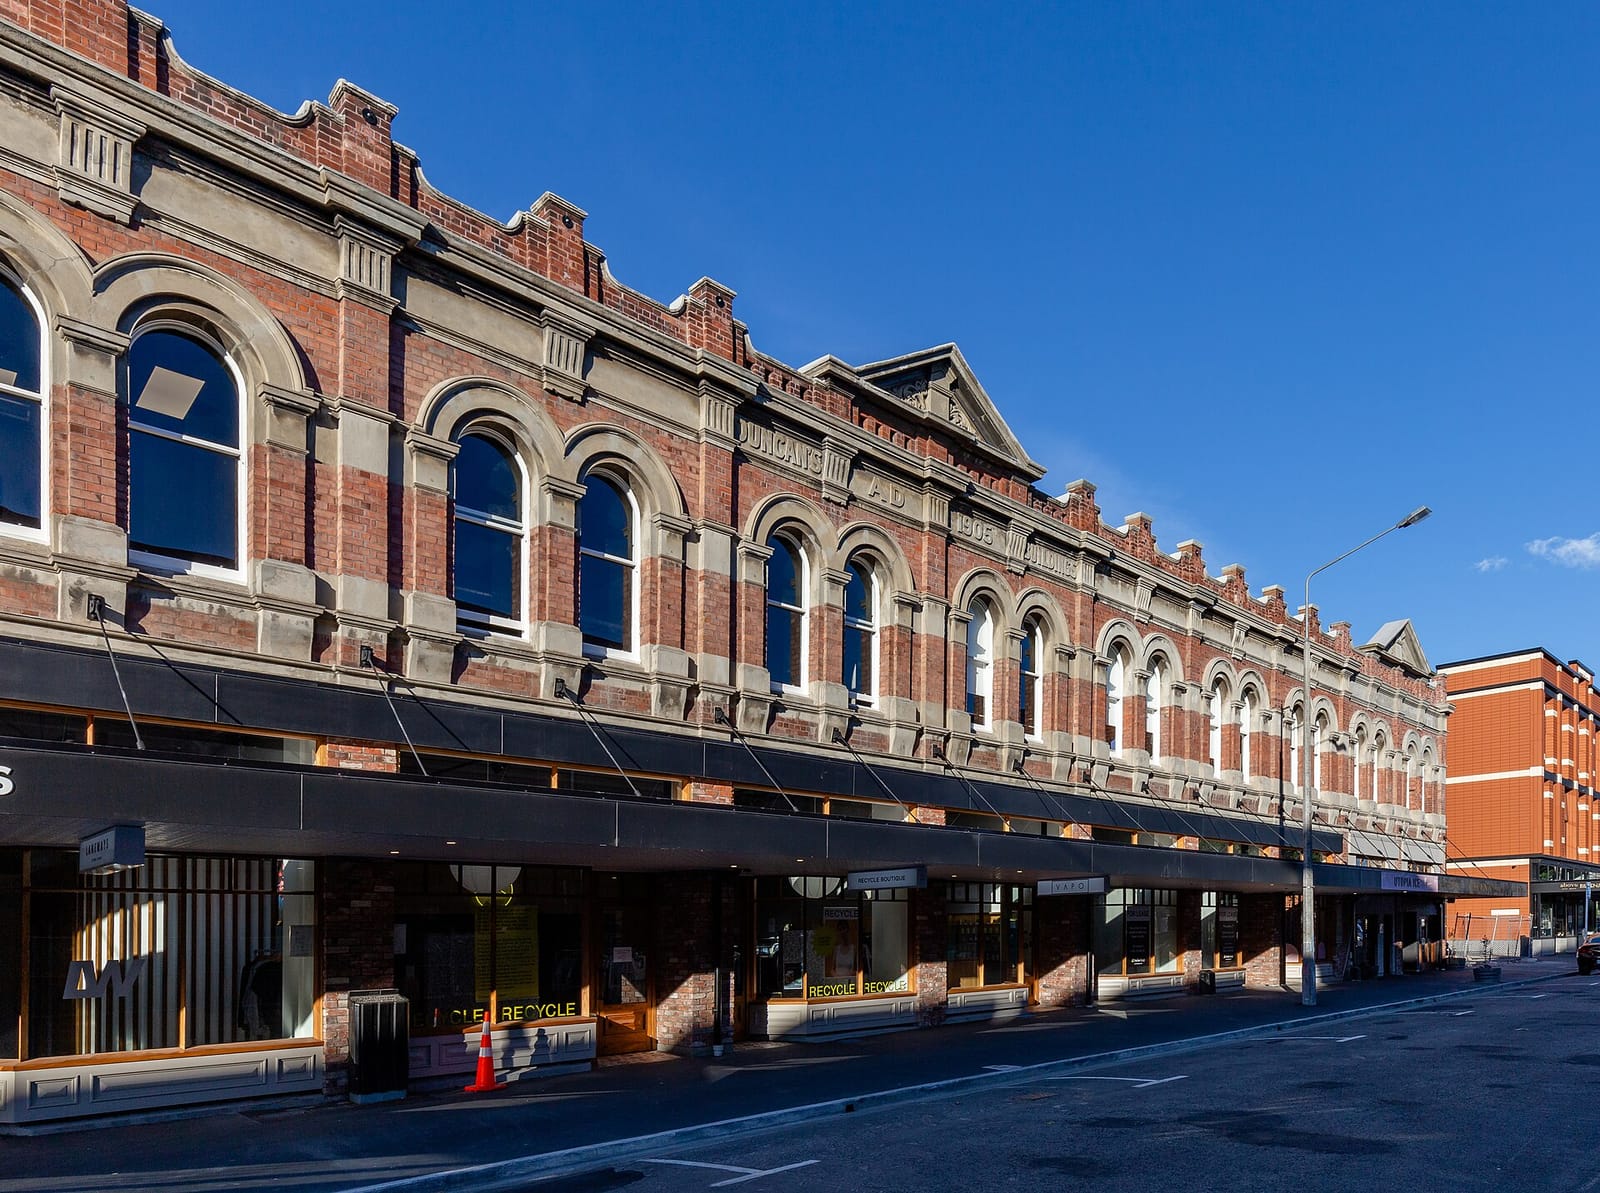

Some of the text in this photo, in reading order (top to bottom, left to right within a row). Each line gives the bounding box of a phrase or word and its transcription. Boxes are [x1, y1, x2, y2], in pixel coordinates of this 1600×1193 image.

[956, 511, 994, 545] 1905
[809, 980, 907, 997] RECYCLE RECYCLE
[502, 1002, 577, 1021] RECYCLE
